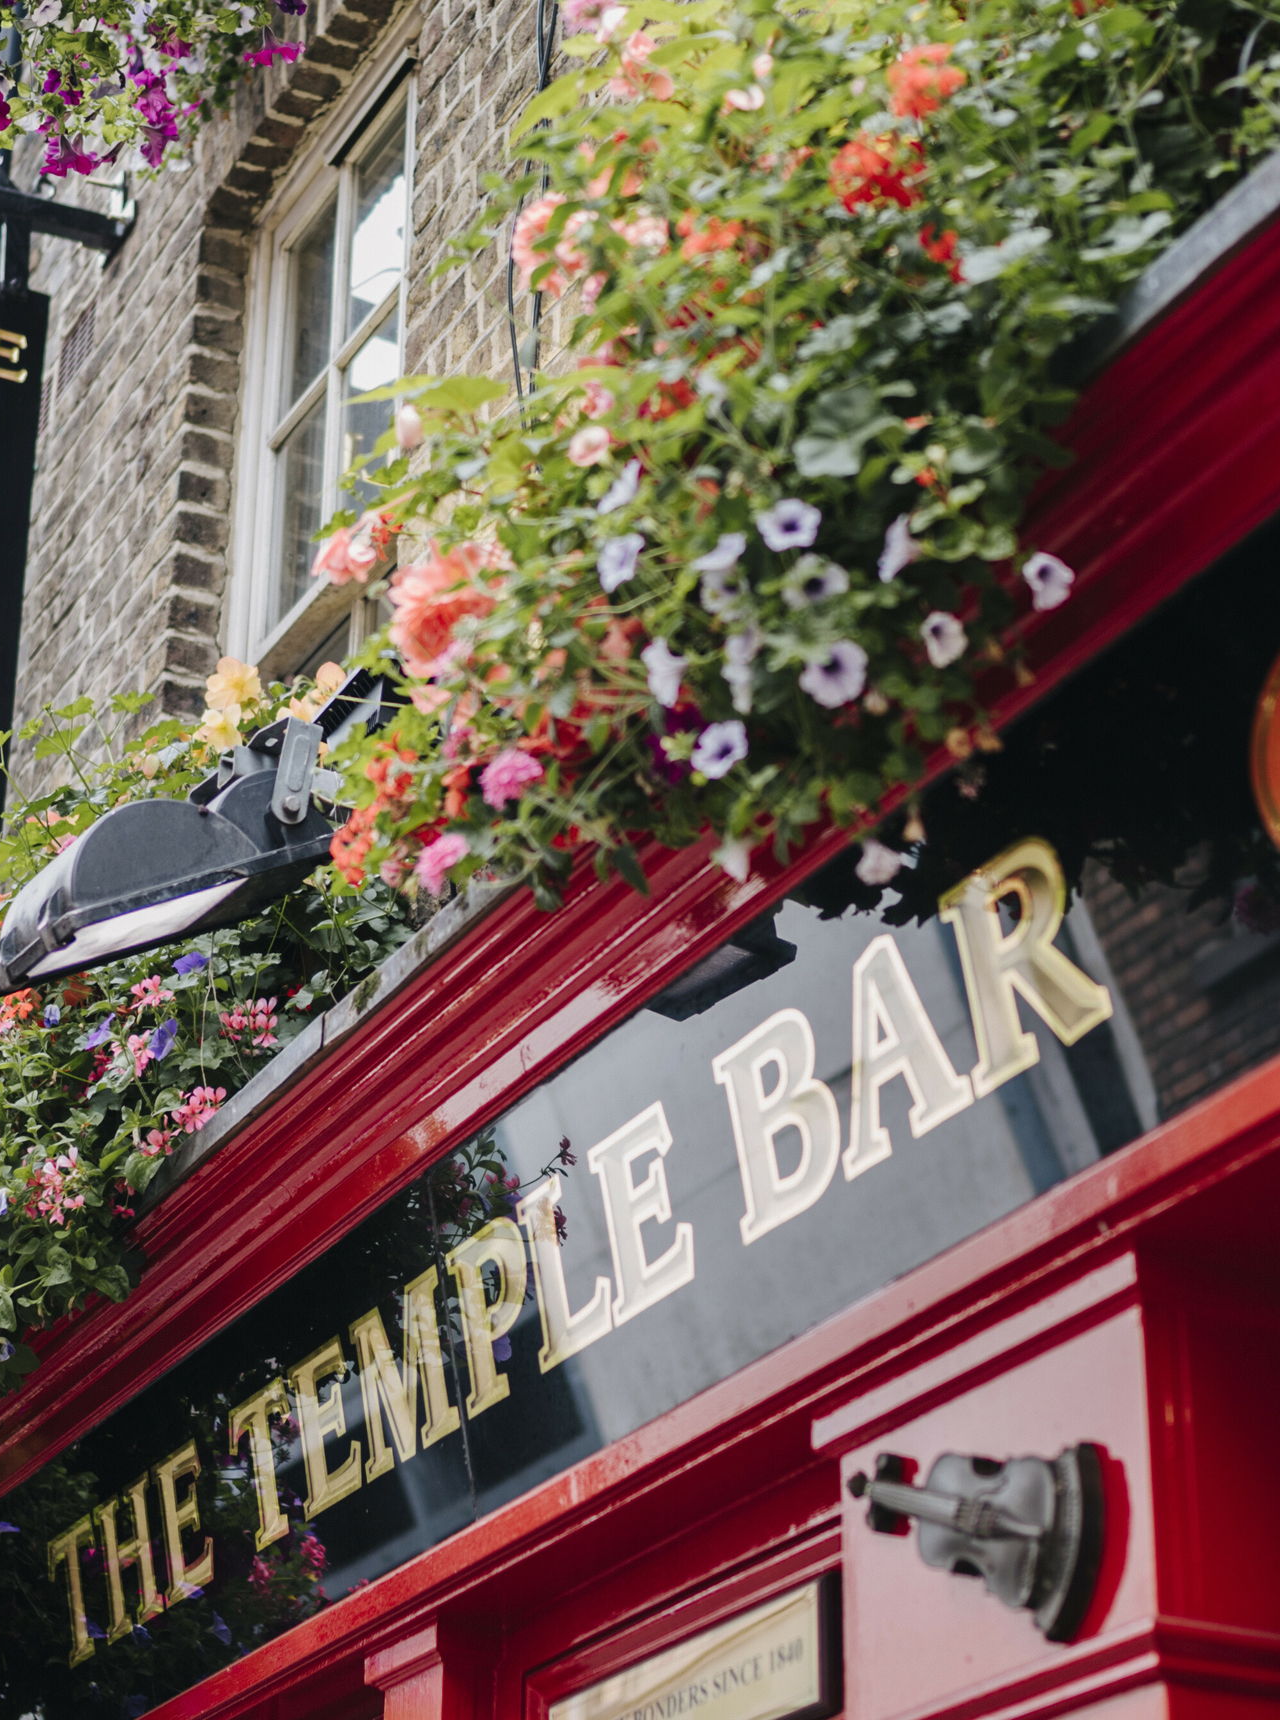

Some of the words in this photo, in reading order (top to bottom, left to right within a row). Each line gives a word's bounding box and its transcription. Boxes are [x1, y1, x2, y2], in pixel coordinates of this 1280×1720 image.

[47, 1437, 214, 1669] THE
[228, 1100, 695, 1551] TEMPLE
[712, 836, 1114, 1246] BAR
[713, 1653, 764, 1695] SINCE
